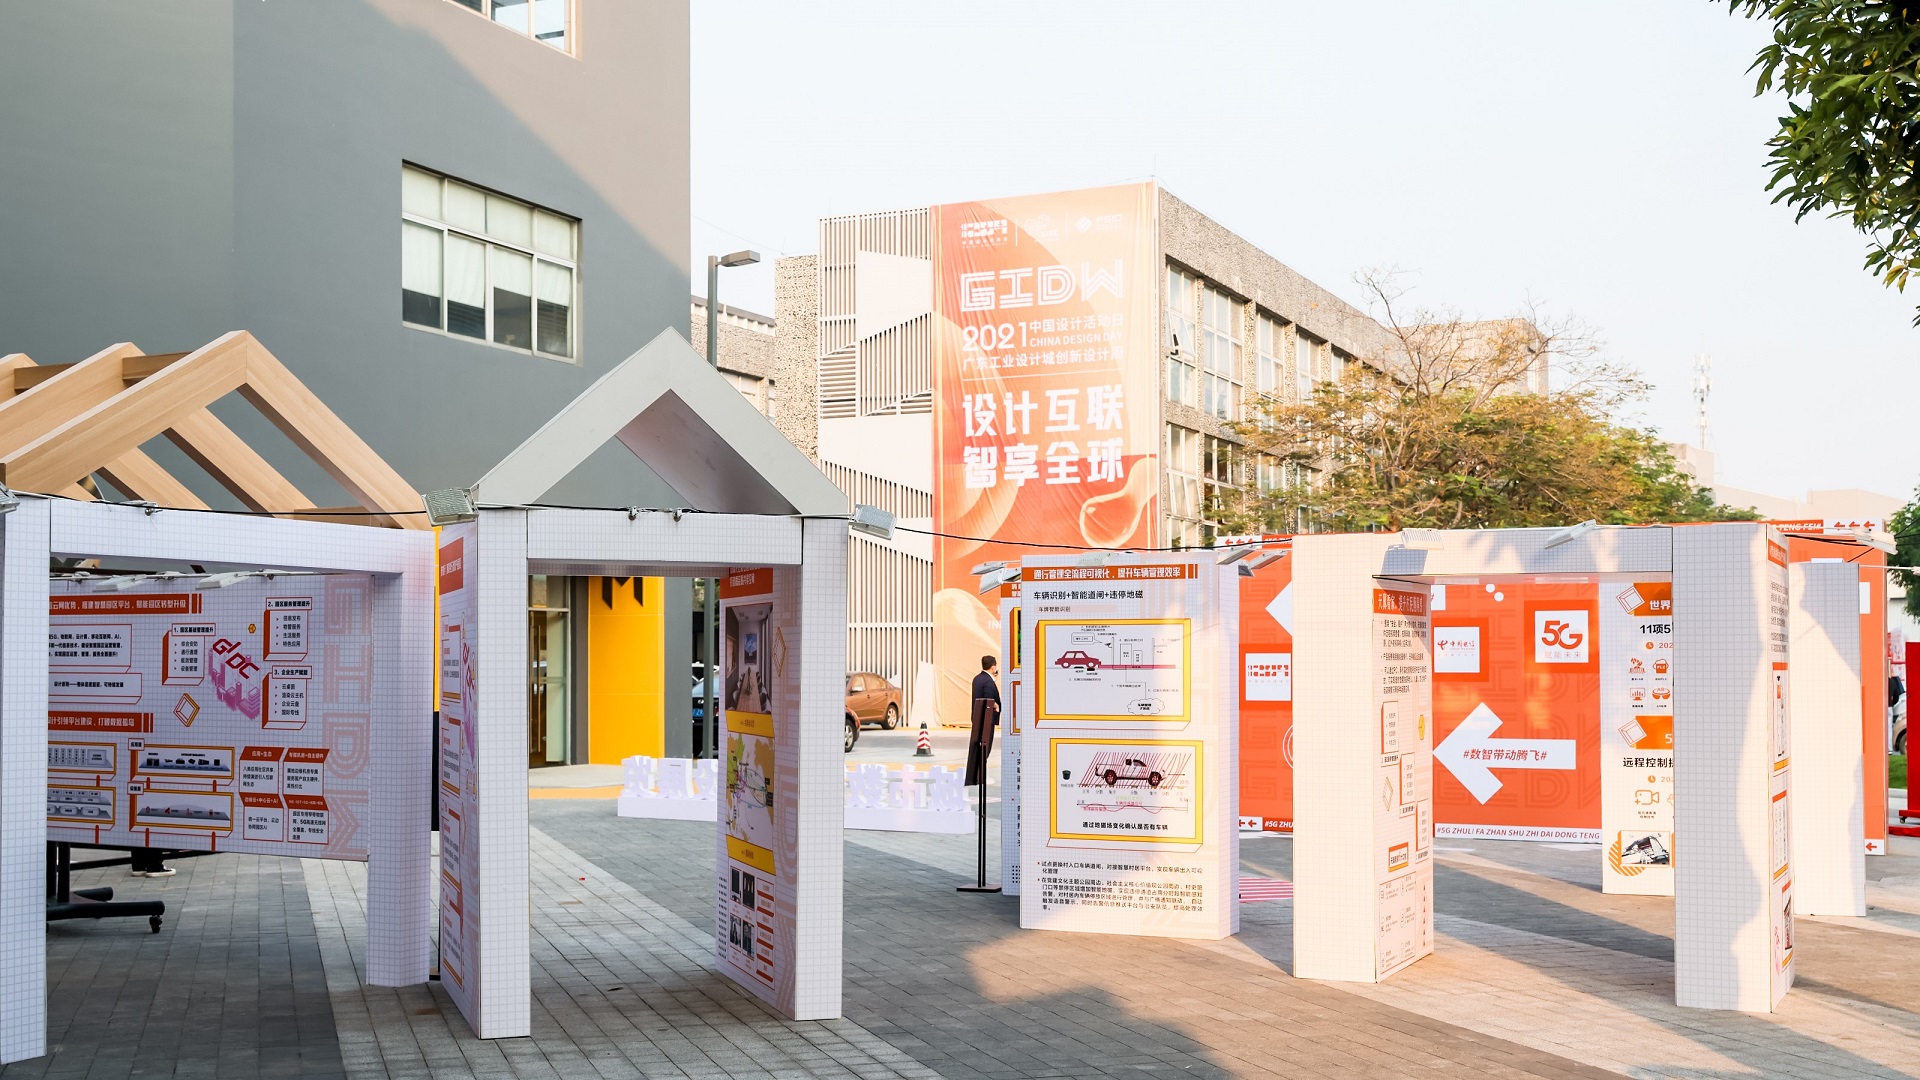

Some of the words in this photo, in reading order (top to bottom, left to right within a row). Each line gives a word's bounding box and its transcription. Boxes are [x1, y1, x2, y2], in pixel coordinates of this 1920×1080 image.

[960, 258, 1124, 313] GIDW
[1029, 314, 1124, 334] 中国设计活动日
[962, 321, 1028, 352] 2021
[1029, 335, 1062, 348] CHINA
[1063, 332, 1102, 346] DESIGN
[1103, 331, 1123, 344] DAY
[962, 383, 1124, 438] 设计互联
[962, 436, 1124, 489] 智享全球
[1033, 589, 1144, 601] 车辆识别+智能道闸+违停地磁
[1649, 599, 1671, 610] 世界
[1541, 620, 1583, 651] 5G
[1463, 746, 1548, 765] #数智带动腾飞#
[1264, 821, 1279, 829] #5G
[1436, 826, 1451, 834] #5G
[1475, 828, 1486, 836] FA
[1486, 828, 1508, 836] ZHAN
[1508, 829, 1525, 837] SHU
[1525, 830, 1539, 838] ZHI
[1540, 831, 1553, 839] DAI
[1554, 831, 1578, 840] DONG
[1580, 832, 1600, 841] TENG
